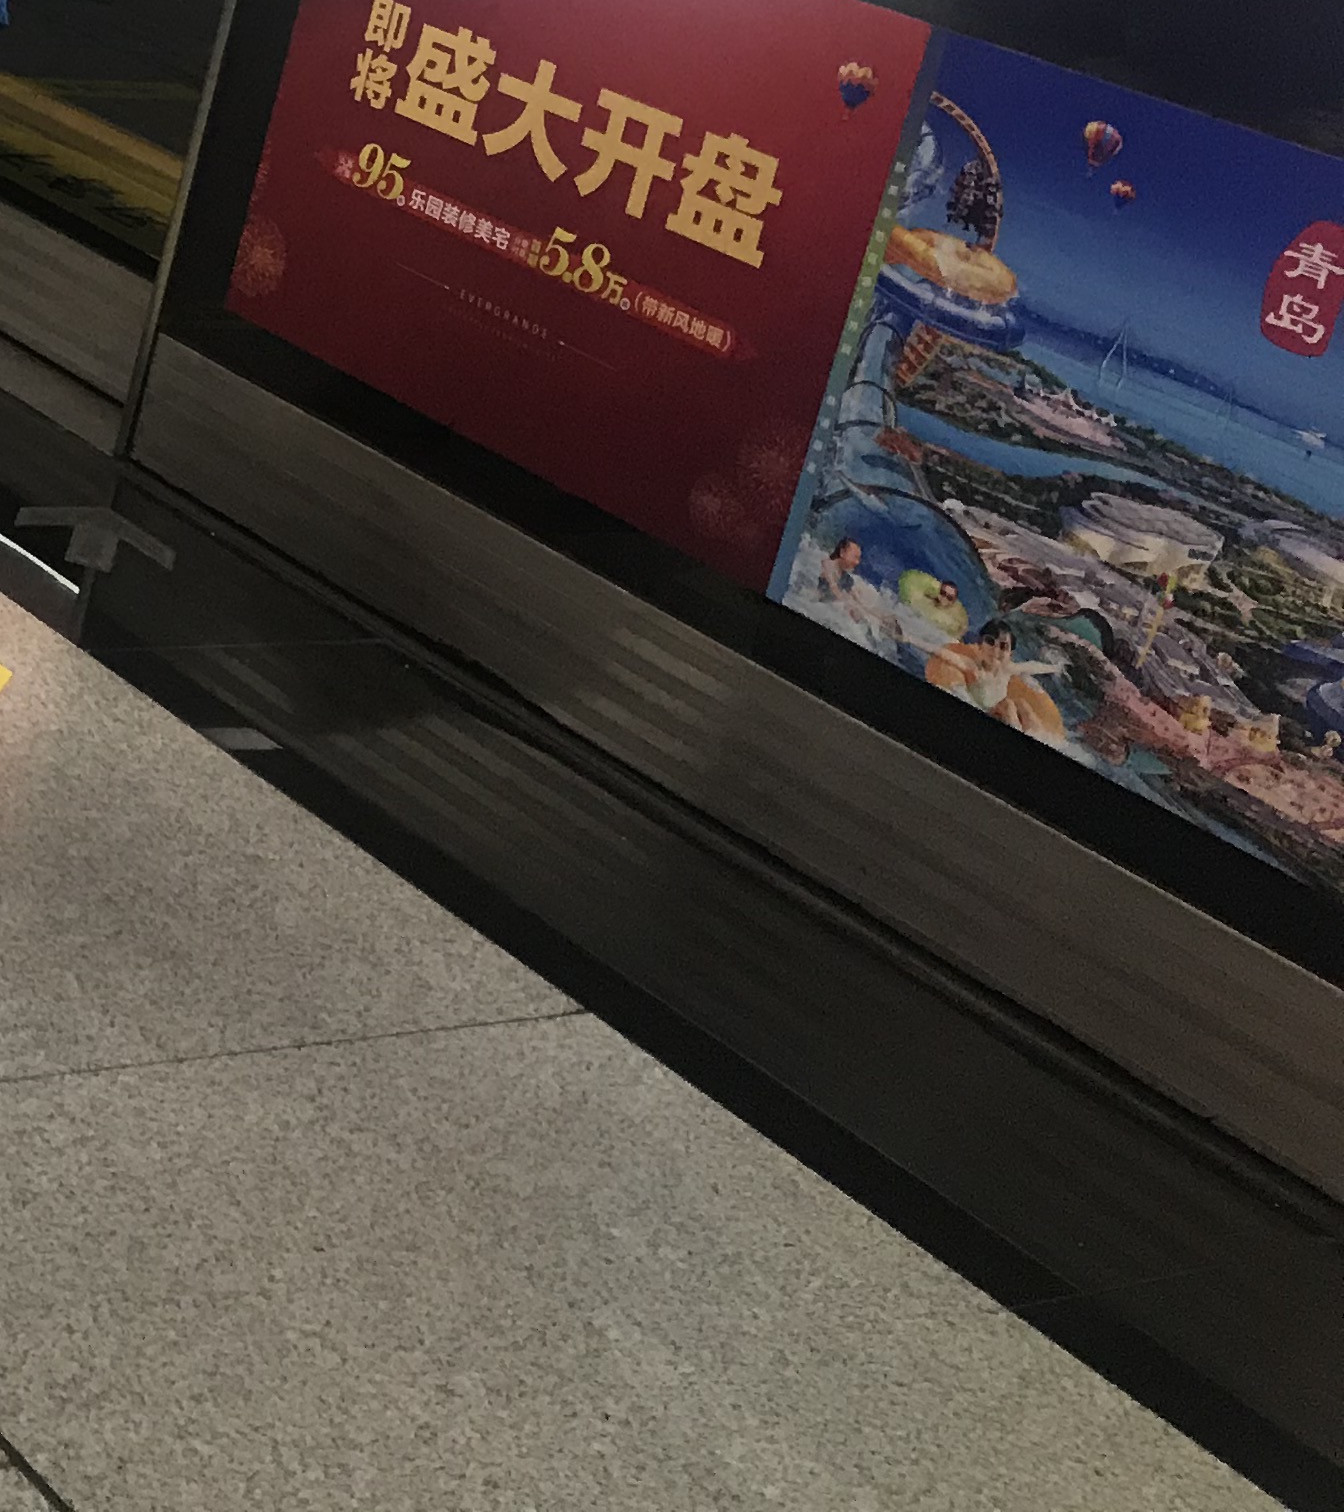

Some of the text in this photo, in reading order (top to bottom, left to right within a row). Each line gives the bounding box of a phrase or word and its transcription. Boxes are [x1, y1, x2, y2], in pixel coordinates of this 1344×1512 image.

[394, 22, 783, 269] 盛大开盘
[408, 188, 512, 251] 乐园装修美宅
[459, 289, 548, 339] EVERGRANDE
[1265, 242, 1344, 344] 青岛
